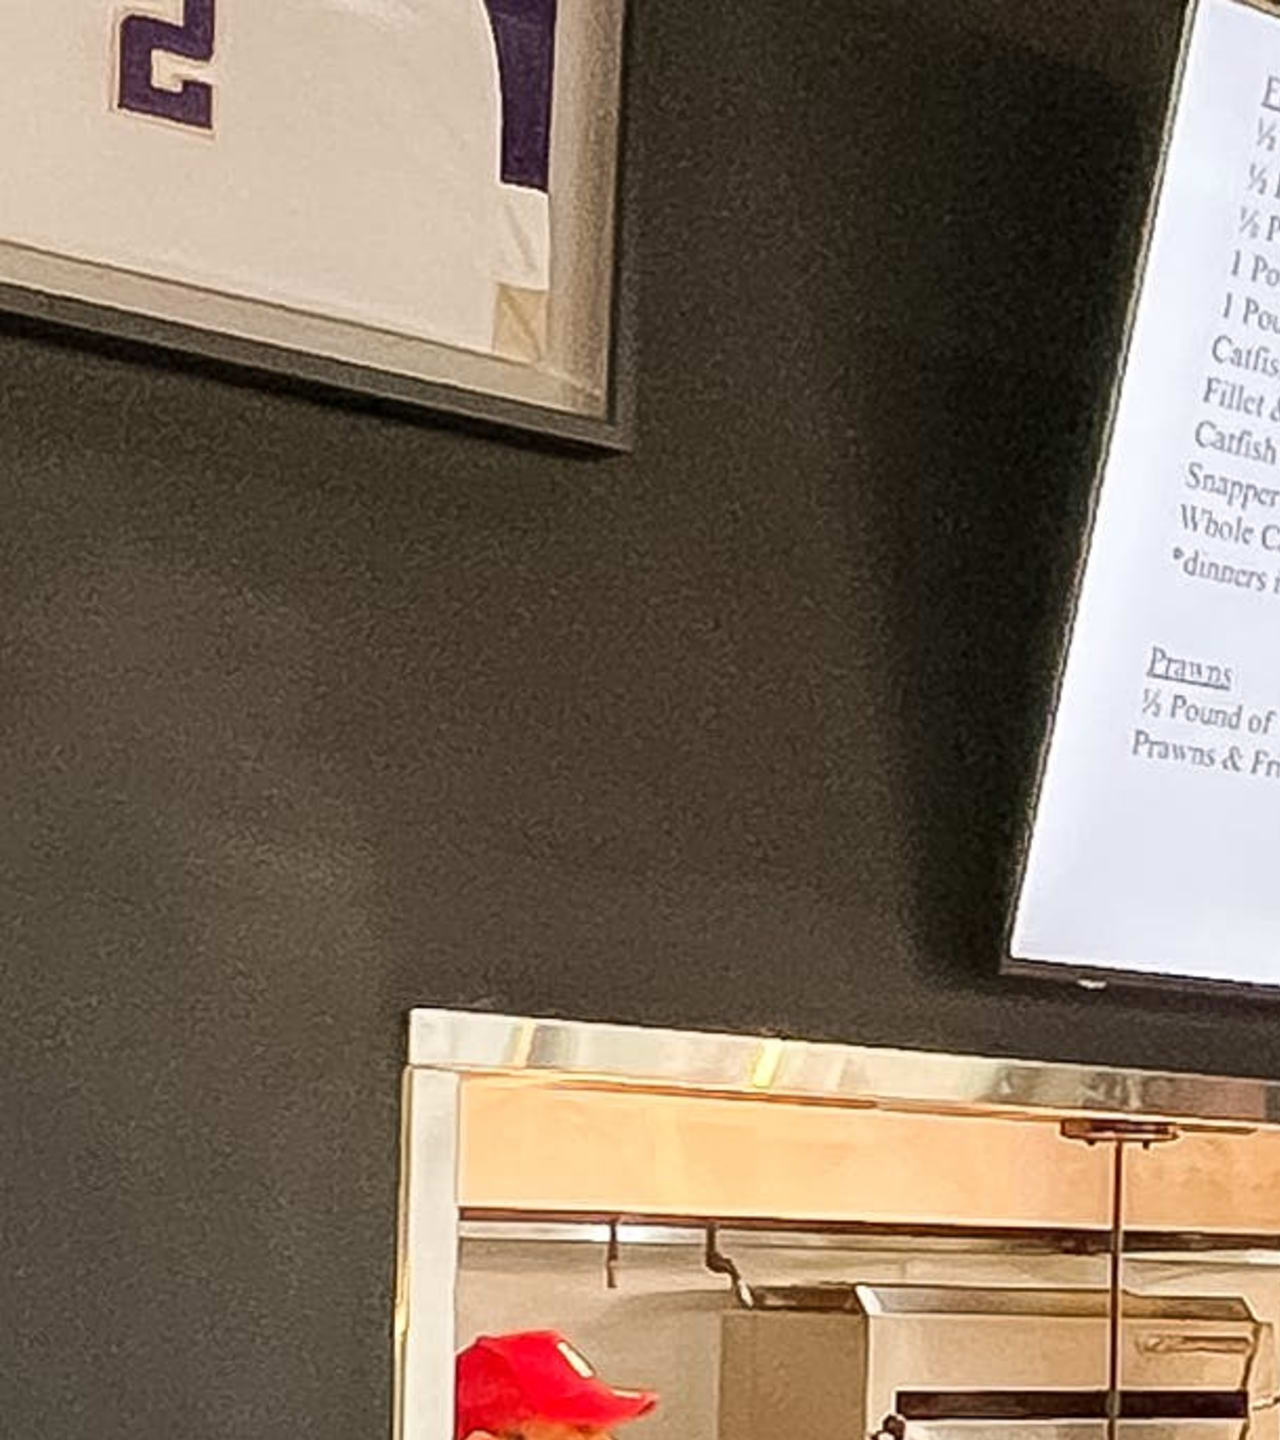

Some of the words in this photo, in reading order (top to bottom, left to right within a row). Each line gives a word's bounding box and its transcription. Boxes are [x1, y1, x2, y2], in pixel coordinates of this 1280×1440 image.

[1231, 249, 1240, 276] 1
[1222, 292, 1232, 318] 1
[1202, 375, 1264, 417] Fillet
[1194, 419, 1276, 465] Catfish
[1185, 461, 1280, 510] Snapper
[1180, 503, 1254, 545] Whole
[1145, 645, 1231, 691] Prawns
[1169, 693, 1242, 730] Pound
[1247, 710, 1276, 734] of
[1131, 728, 1215, 767] Prawns
[1221, 745, 1242, 772] &
